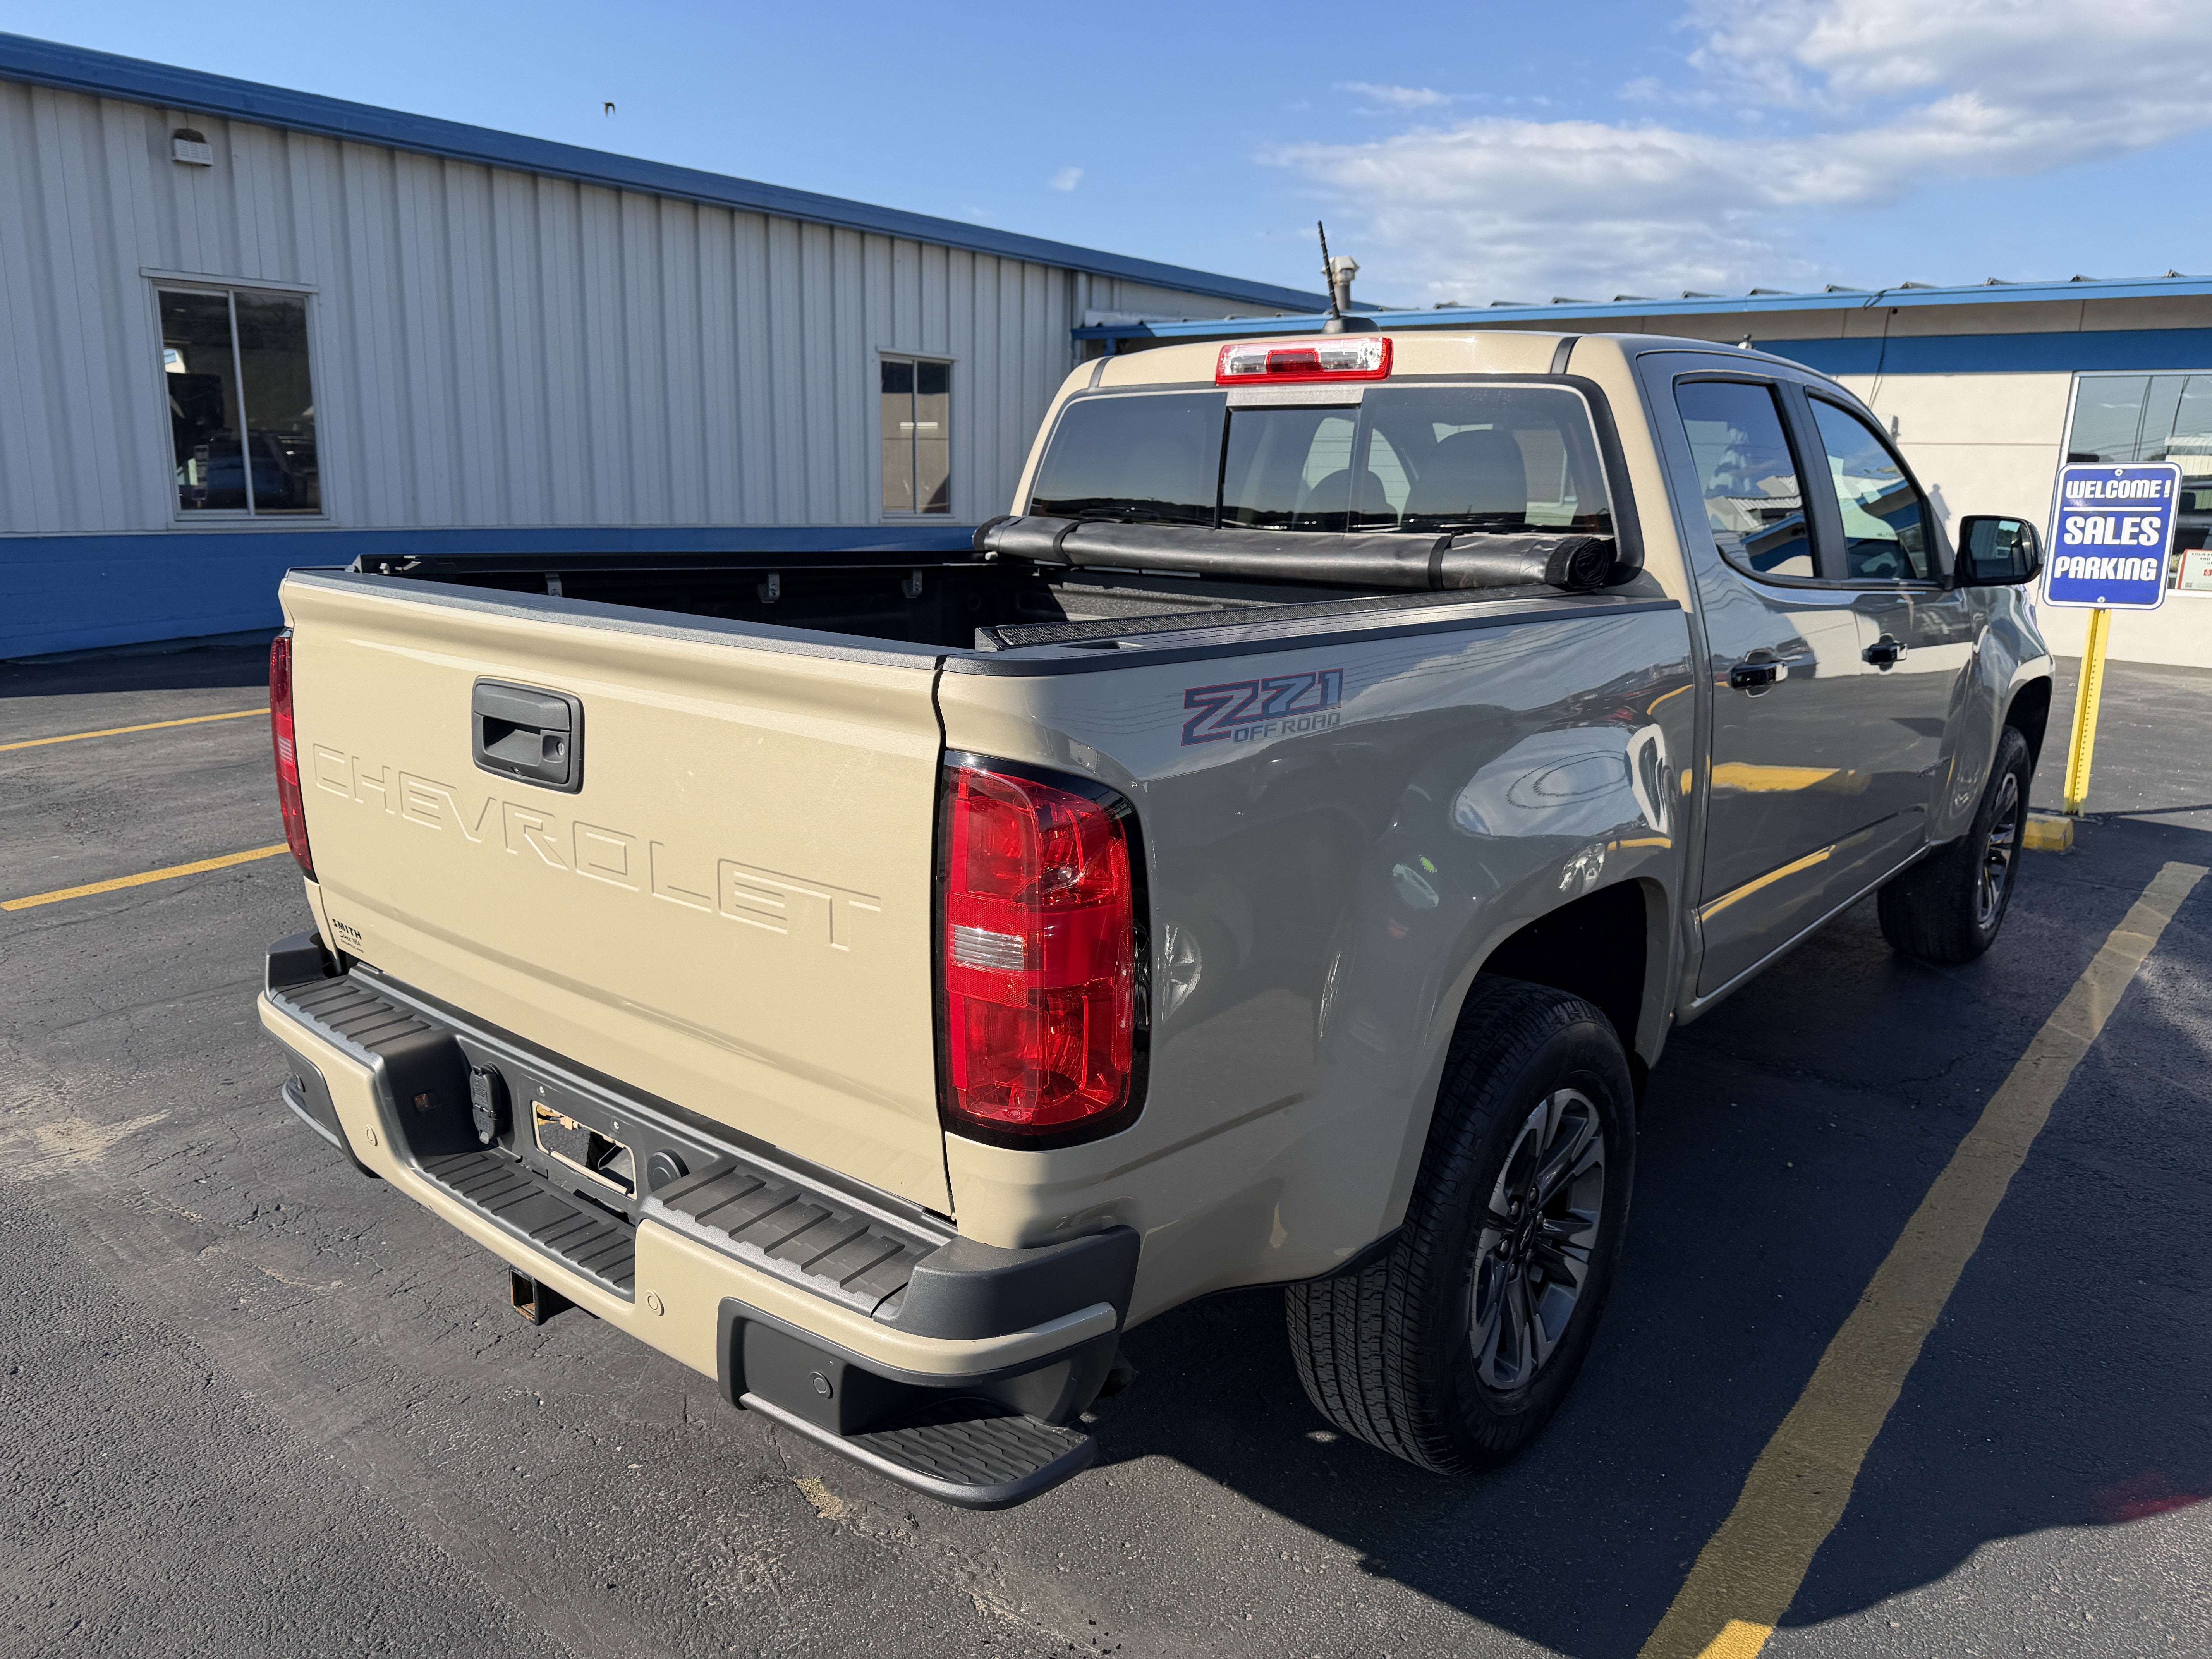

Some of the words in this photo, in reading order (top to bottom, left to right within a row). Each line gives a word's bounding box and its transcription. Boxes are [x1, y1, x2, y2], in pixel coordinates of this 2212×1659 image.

[2063, 516, 2161, 546] SALES
[2054, 556, 2158, 581] PARKING
[1181, 668, 1343, 746] Z71
[1234, 723, 1277, 743] OFF
[1281, 712, 1340, 734] ROAD
[313, 744, 881, 951] CHEVROLET
[332, 918, 362, 940] SMITH
